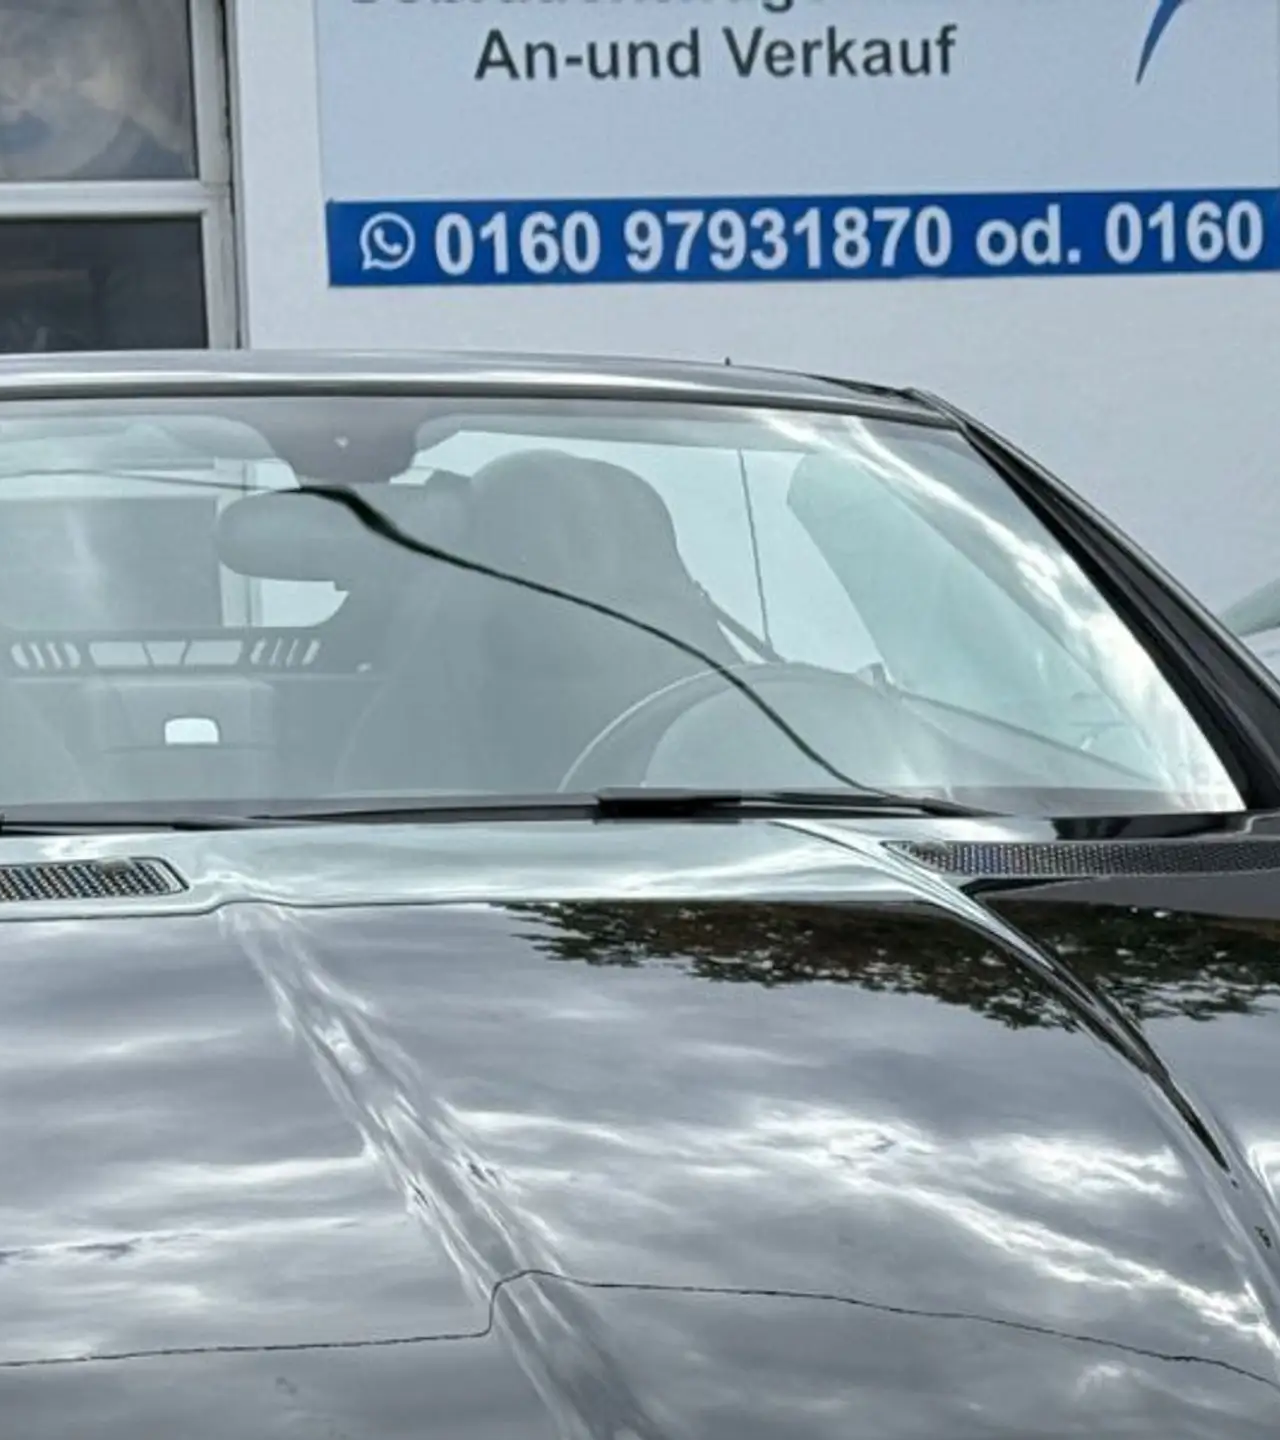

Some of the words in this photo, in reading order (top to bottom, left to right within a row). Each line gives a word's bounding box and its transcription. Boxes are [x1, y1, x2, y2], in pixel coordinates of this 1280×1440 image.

[474, 27, 701, 81] An-und
[723, 24, 958, 77] Verkauf
[435, 212, 600, 275] 0160
[625, 206, 952, 271] 97931870
[975, 203, 1081, 266] od.
[1106, 200, 1263, 263] 0160
